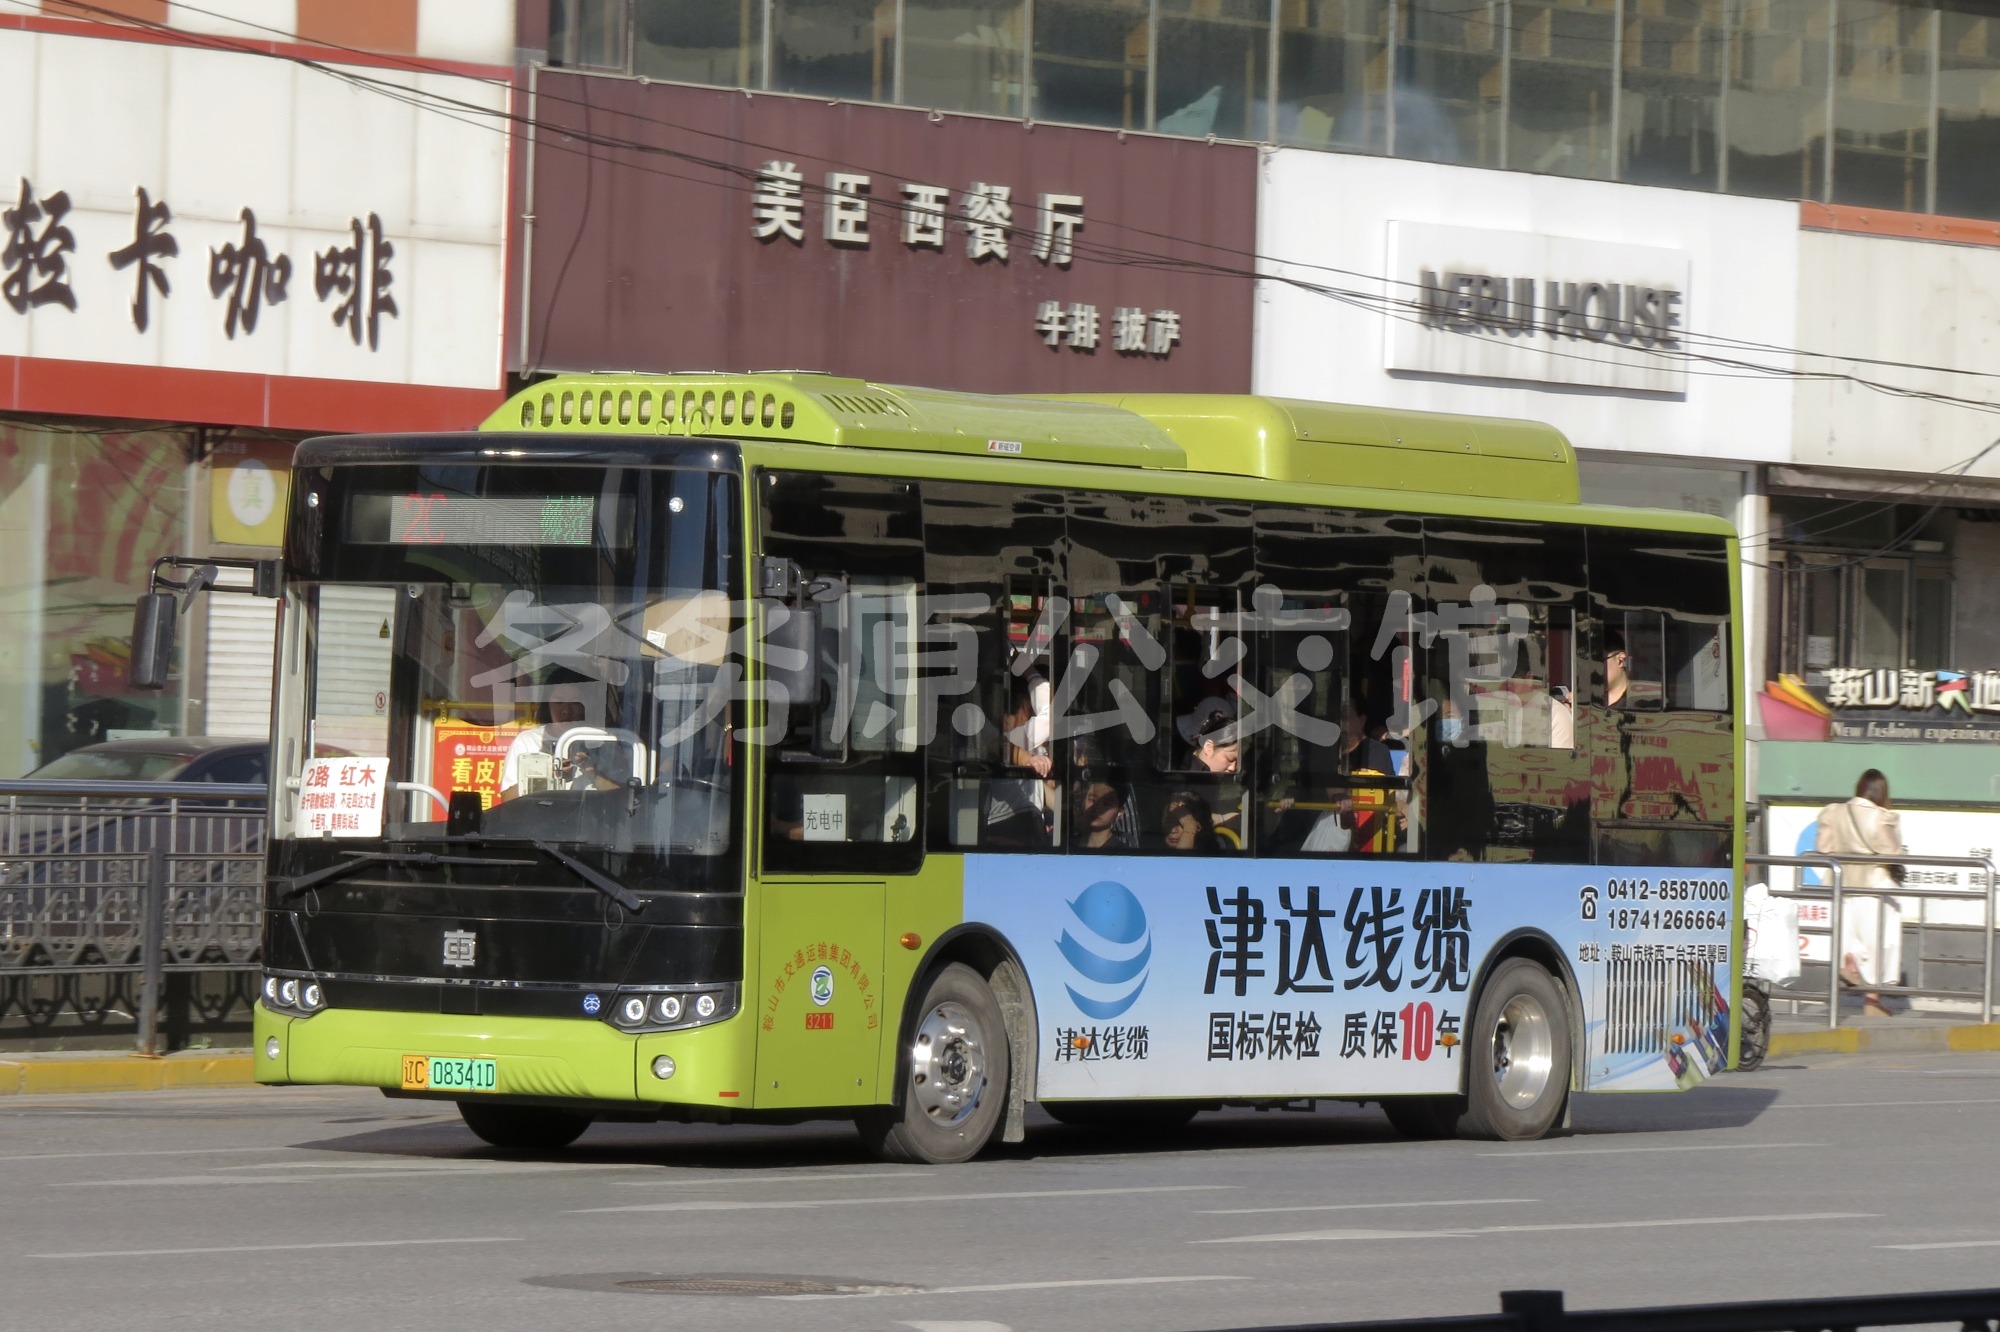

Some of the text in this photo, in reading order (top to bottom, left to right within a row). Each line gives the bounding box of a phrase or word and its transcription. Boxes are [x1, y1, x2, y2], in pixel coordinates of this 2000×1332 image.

[752, 160, 1084, 264] 美臣西餐厅
[1, 176, 398, 352] 轻卡咖啡
[1034, 300, 1180, 354] 牛排 披萨
[1546, 280, 1682, 350] HOUSE
[306, 764, 376, 788] 2路 红木
[805, 809, 843, 830] 充电中
[1607, 878, 1728, 901] 0412-8587000
[1203, 886, 1473, 997] 津达线缆
[1608, 909, 1726, 930] 18741266664
[762, 941, 878, 1032] 鞍山市交通运输集团有限公司
[806, 1013, 834, 1030] 3211
[1054, 1025, 1150, 1061] 津达线缆
[1207, 1001, 1461, 1062] 国标保检 质保10年
